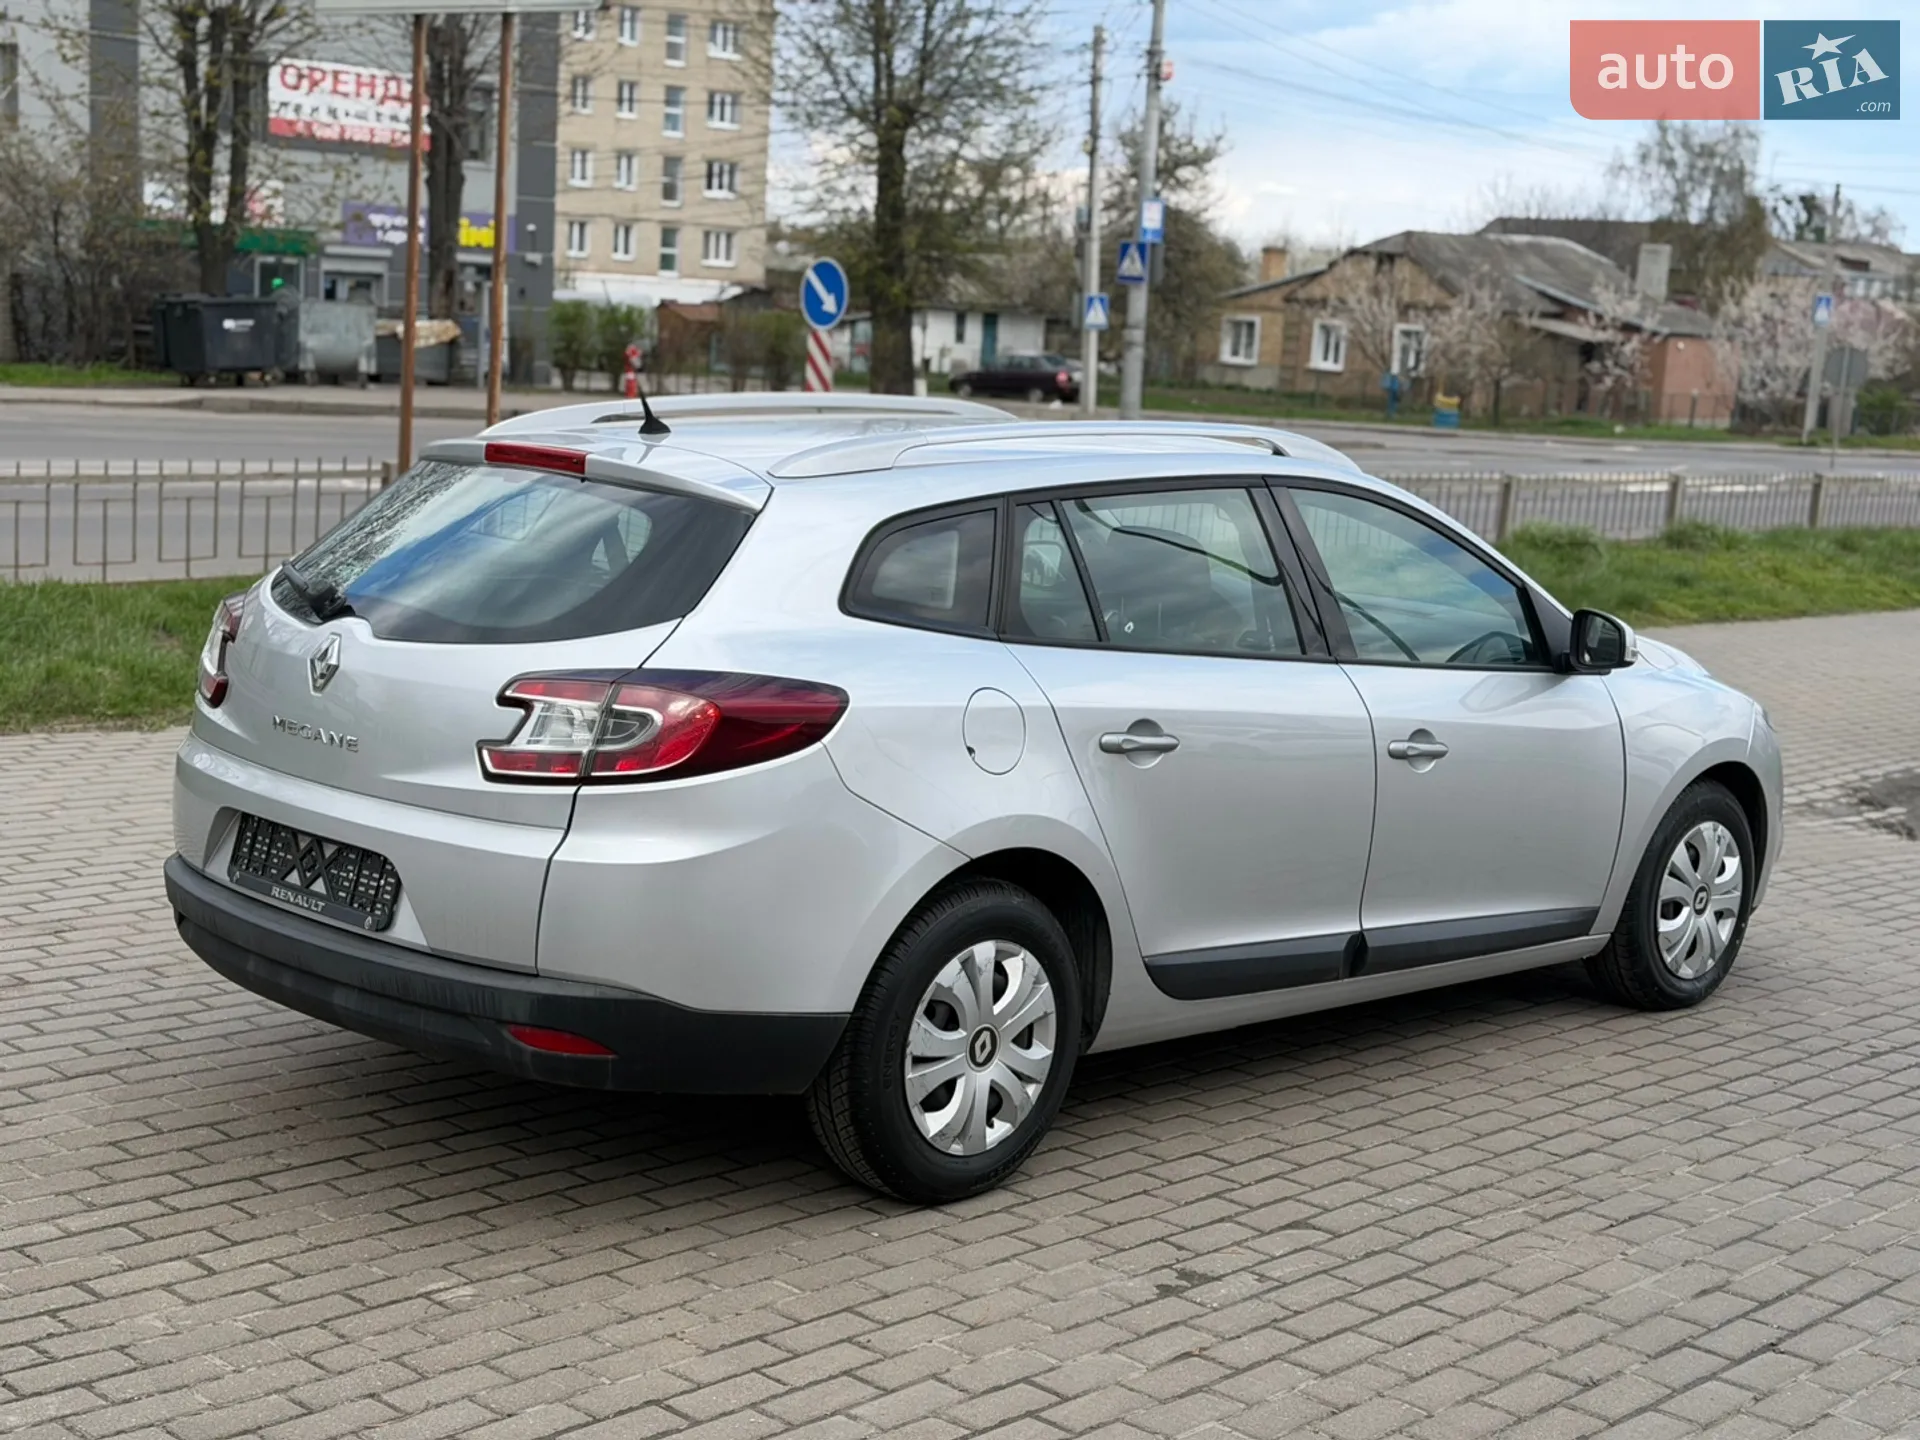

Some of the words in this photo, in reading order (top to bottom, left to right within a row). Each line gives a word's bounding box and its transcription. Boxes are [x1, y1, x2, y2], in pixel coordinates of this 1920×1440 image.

[279, 63, 430, 108] ОРЕНД
[272, 714, 359, 753] MEGANE
[270, 886, 326, 913] RENAULT
[883, 1010, 902, 1092] ENERGY
